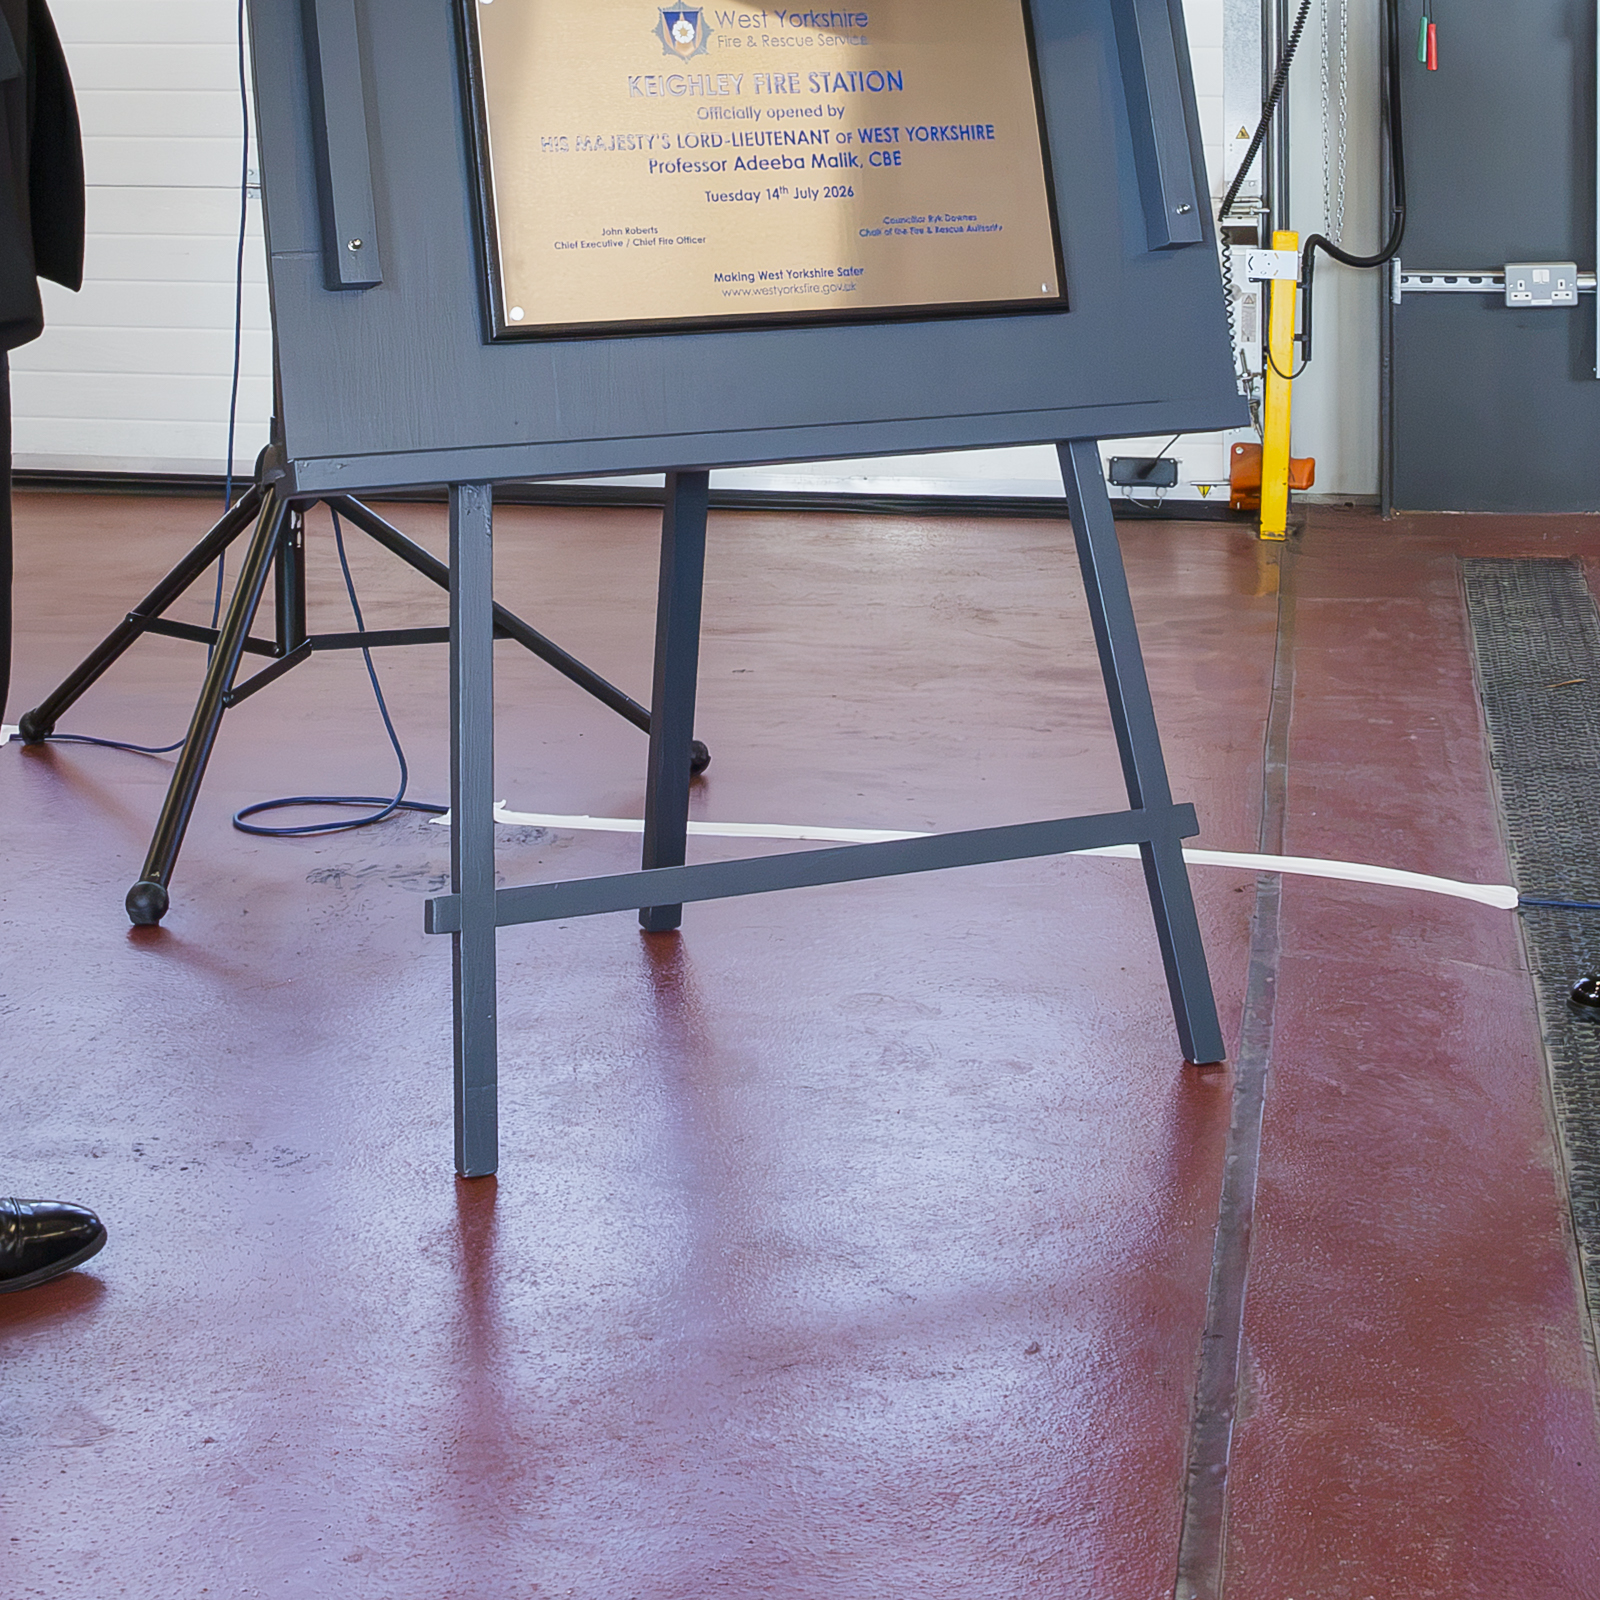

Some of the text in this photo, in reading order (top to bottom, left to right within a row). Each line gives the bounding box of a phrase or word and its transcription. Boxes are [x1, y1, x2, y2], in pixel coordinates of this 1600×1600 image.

[715, 9, 869, 28] West Yorkshire
[718, 34, 868, 48] Fire & Rescue Service
[628, 69, 903, 97] KEIGHLEY FIRE STATION
[697, 104, 845, 121] Officially opened by
[540, 136, 570, 152] HIS
[575, 134, 671, 151] MAJESTY'S
[677, 129, 830, 148] LORD-LIEUTENANT
[857, 127, 899, 143] WEST
[905, 124, 995, 142] YORKSHIRE
[649, 150, 902, 174] Professor Adeeba Malik, CBE
[705, 185, 854, 203] Tuesday 14th July 2026
[602, 227, 658, 236] John Roberts
[554, 236, 706, 250] Chief Executive / Chief Fire Officer
[714, 266, 864, 283] Making West Yorkshire Safer
[722, 282, 857, 297] www.westyorksfire.gov.uk
